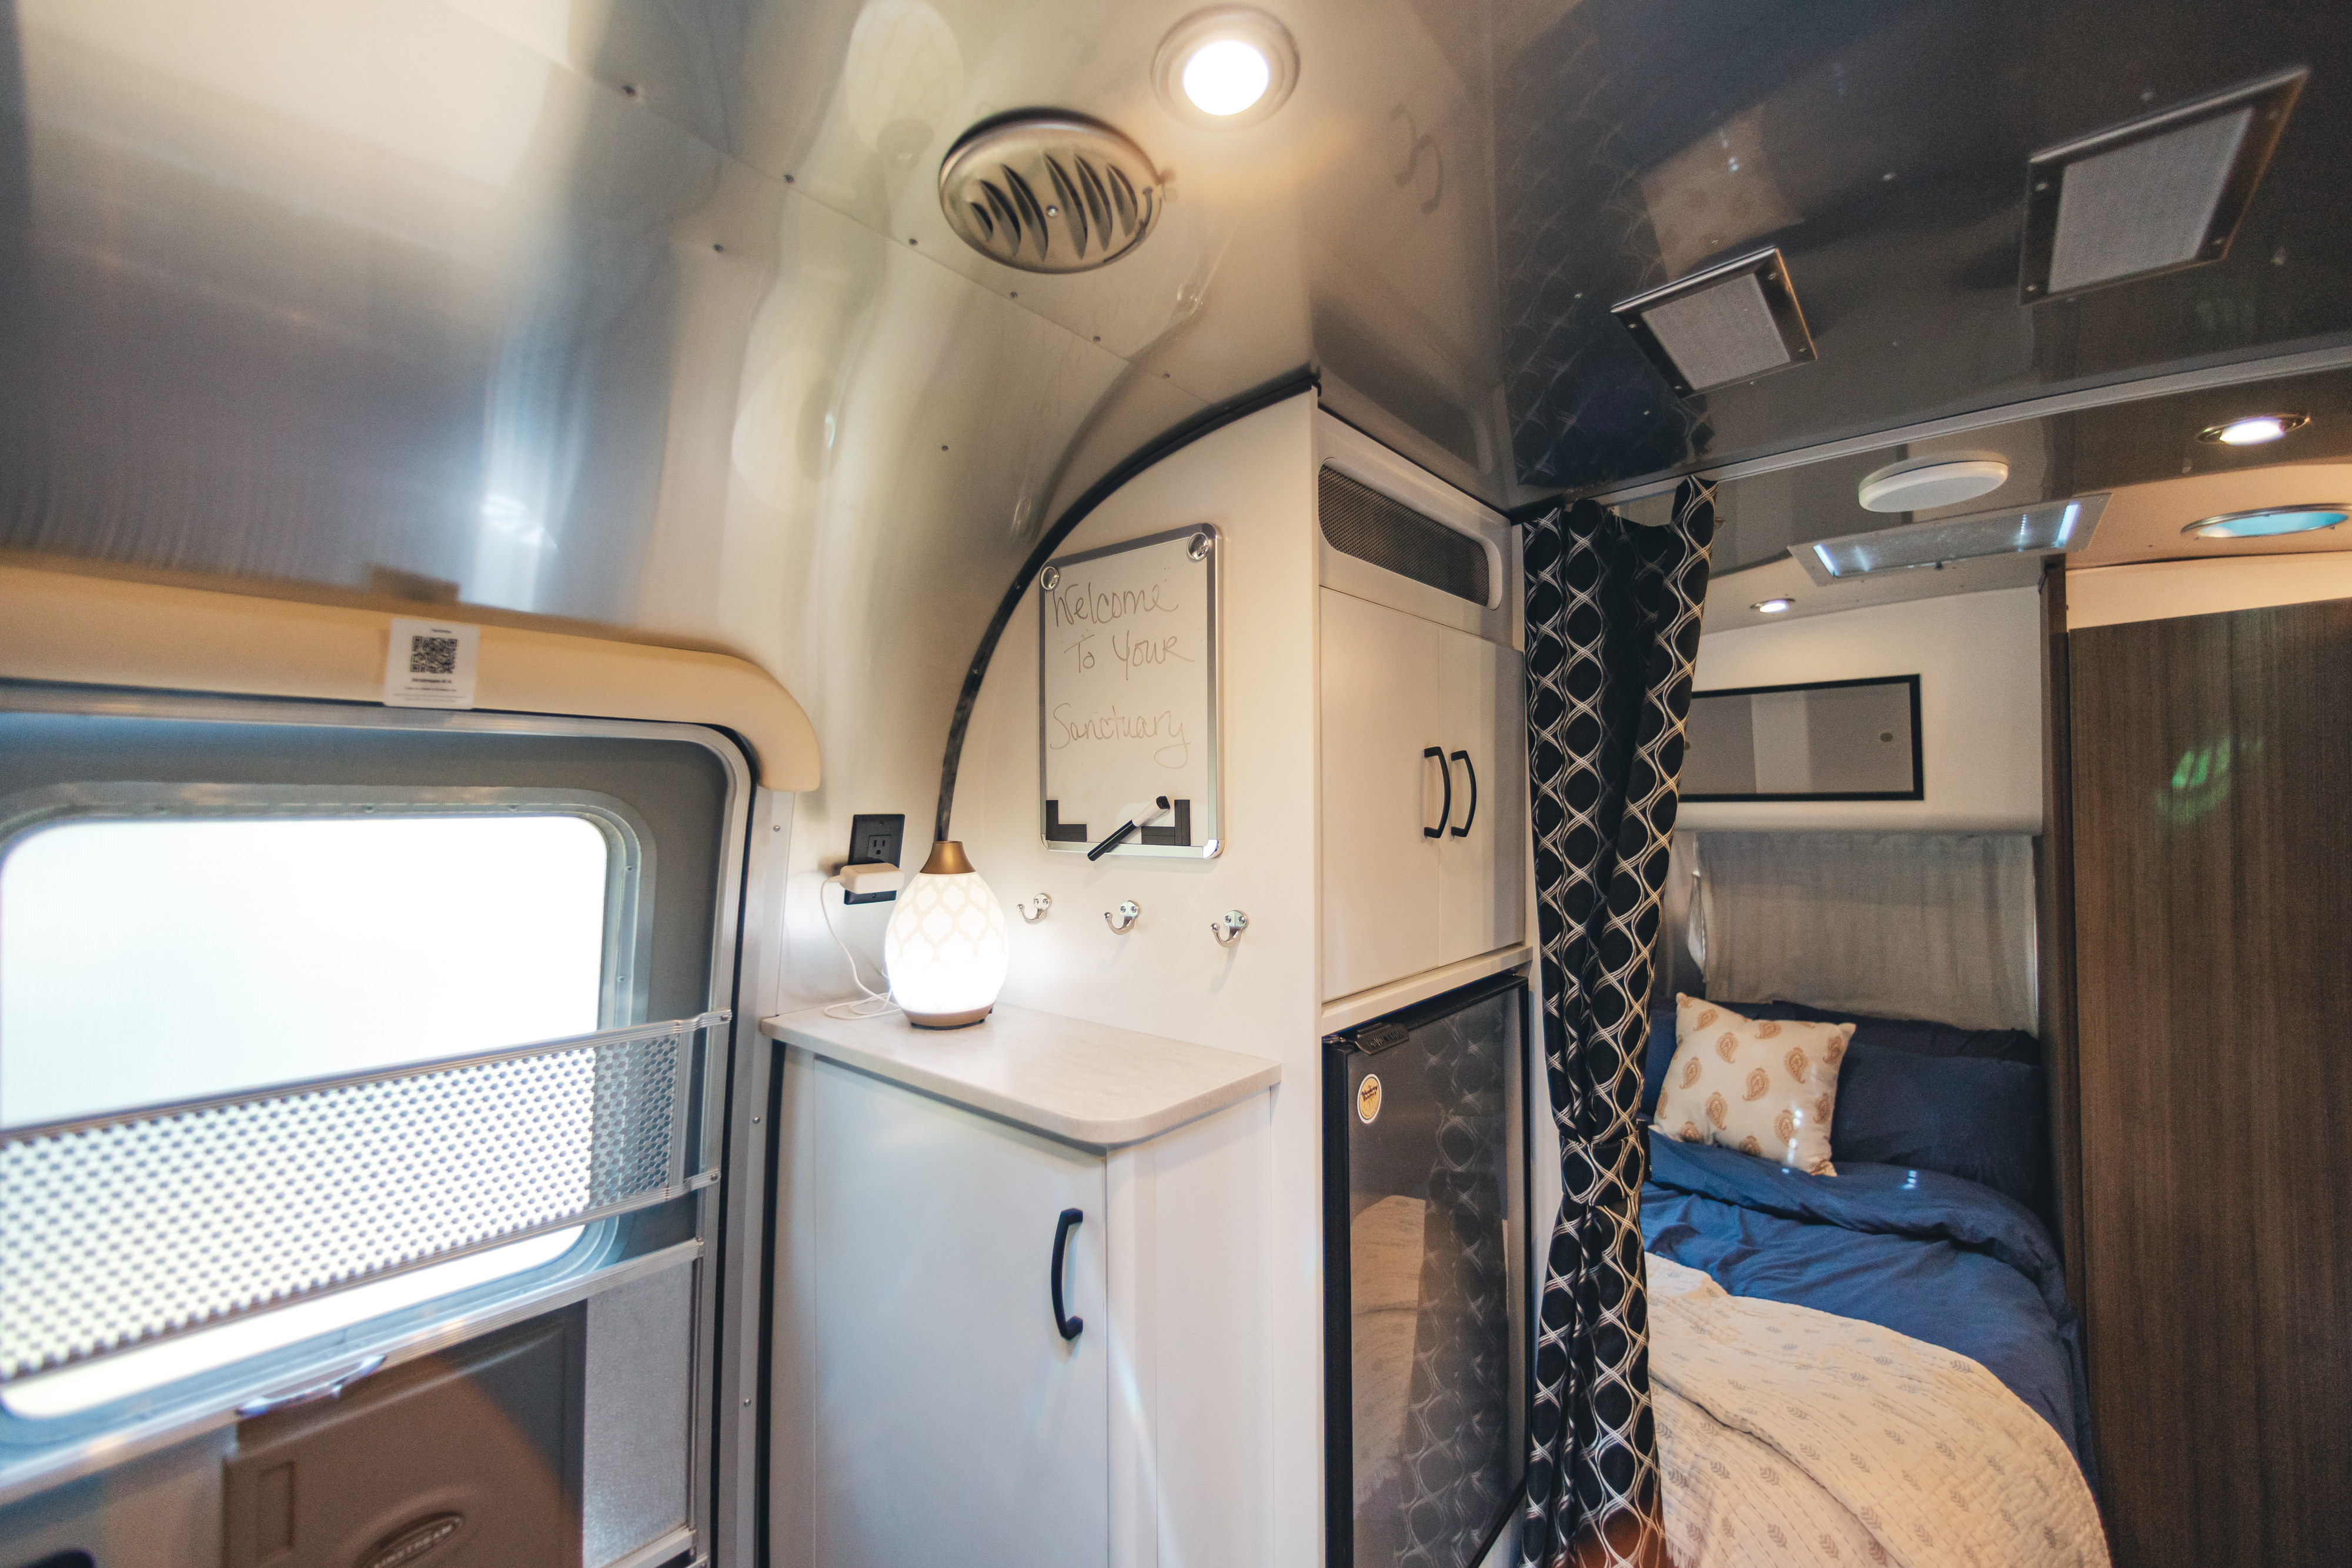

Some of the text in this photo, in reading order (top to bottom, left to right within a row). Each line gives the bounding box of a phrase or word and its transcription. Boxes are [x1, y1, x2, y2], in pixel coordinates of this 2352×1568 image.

[1053, 583, 1179, 627] Welcome
[1064, 634, 1095, 673] To
[1050, 703, 1191, 769] Sanctuary
